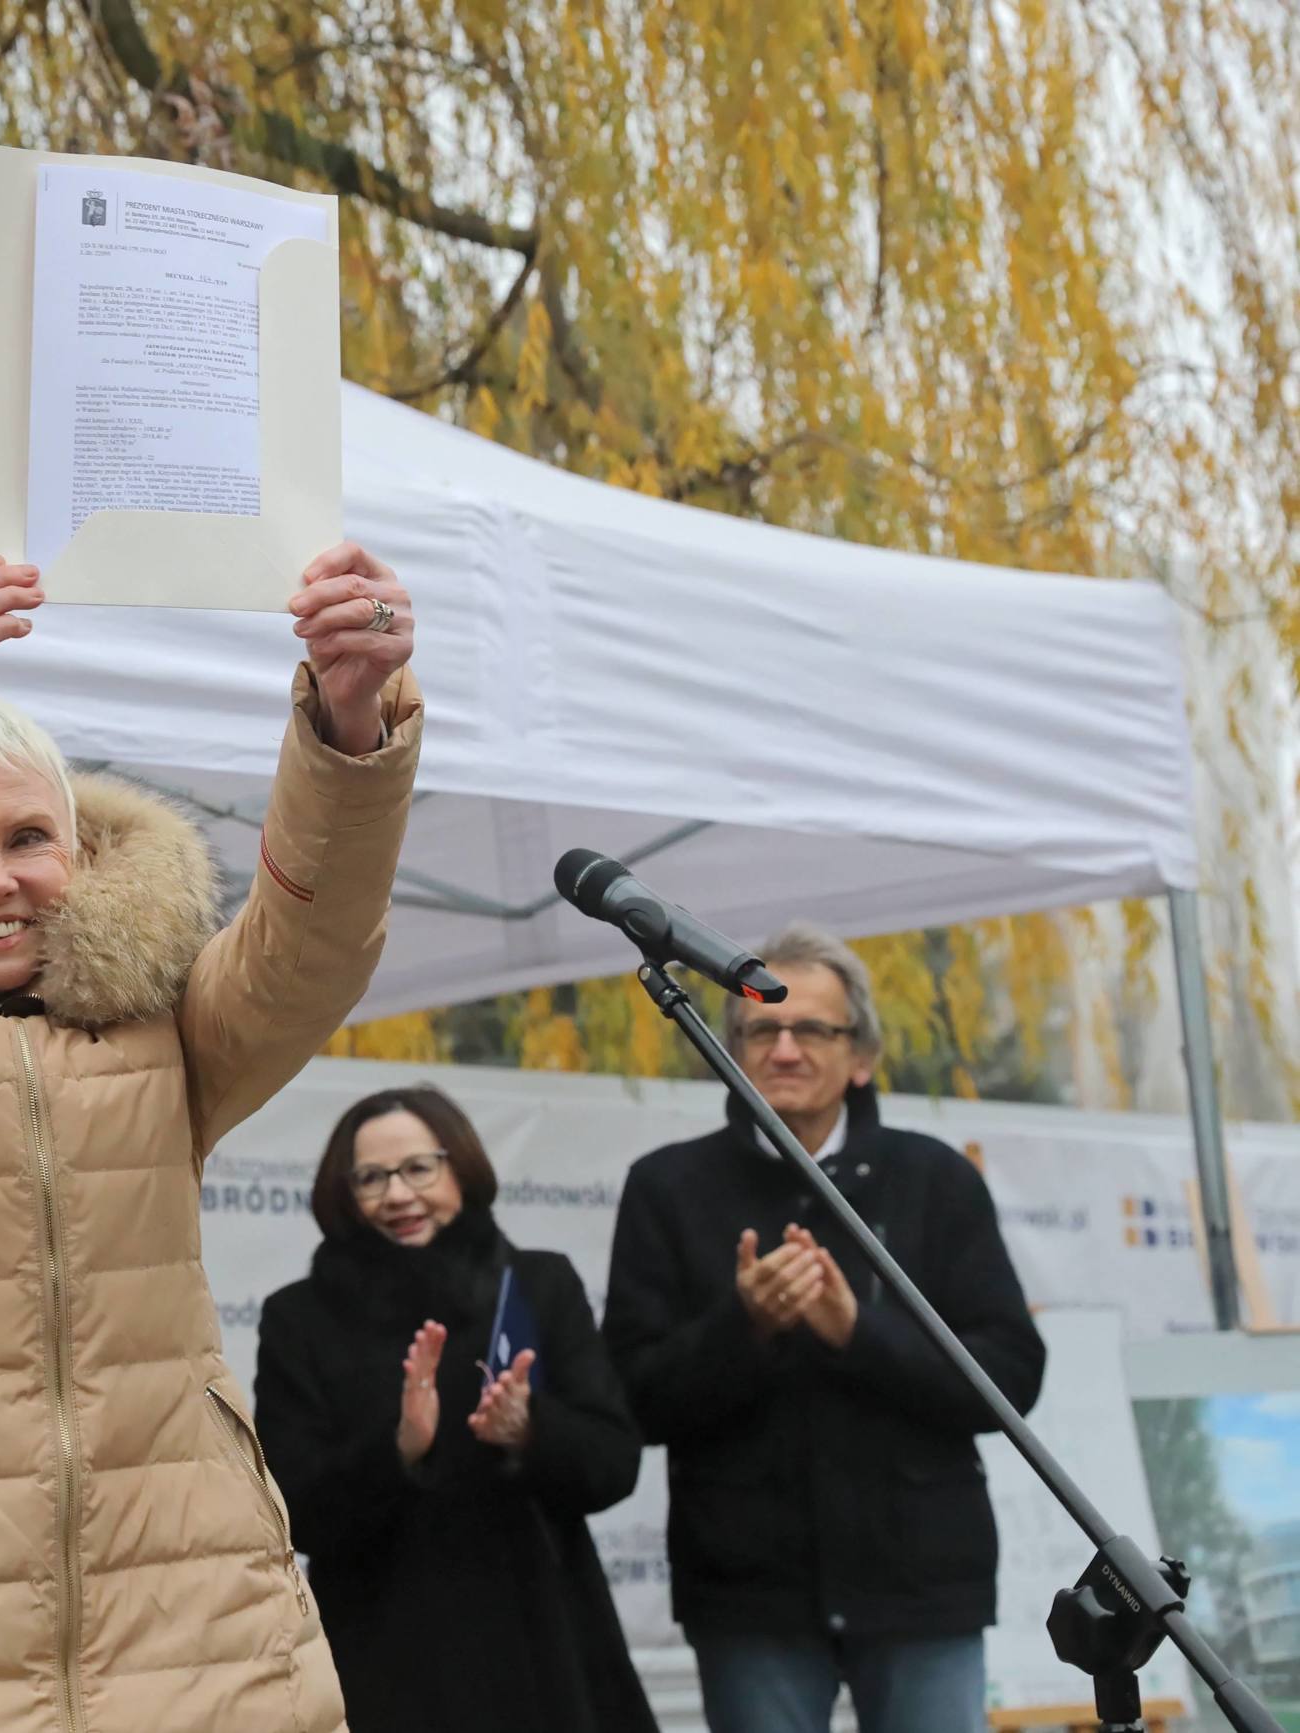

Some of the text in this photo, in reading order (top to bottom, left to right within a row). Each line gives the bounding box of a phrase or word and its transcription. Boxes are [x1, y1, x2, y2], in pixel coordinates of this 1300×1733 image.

[125, 201, 160, 212] PREZYDENT
[162, 206, 185, 216] MIASTA
[230, 217, 264, 231] WARSZAWY
[1102, 1564, 1141, 1613] DYNAWID
